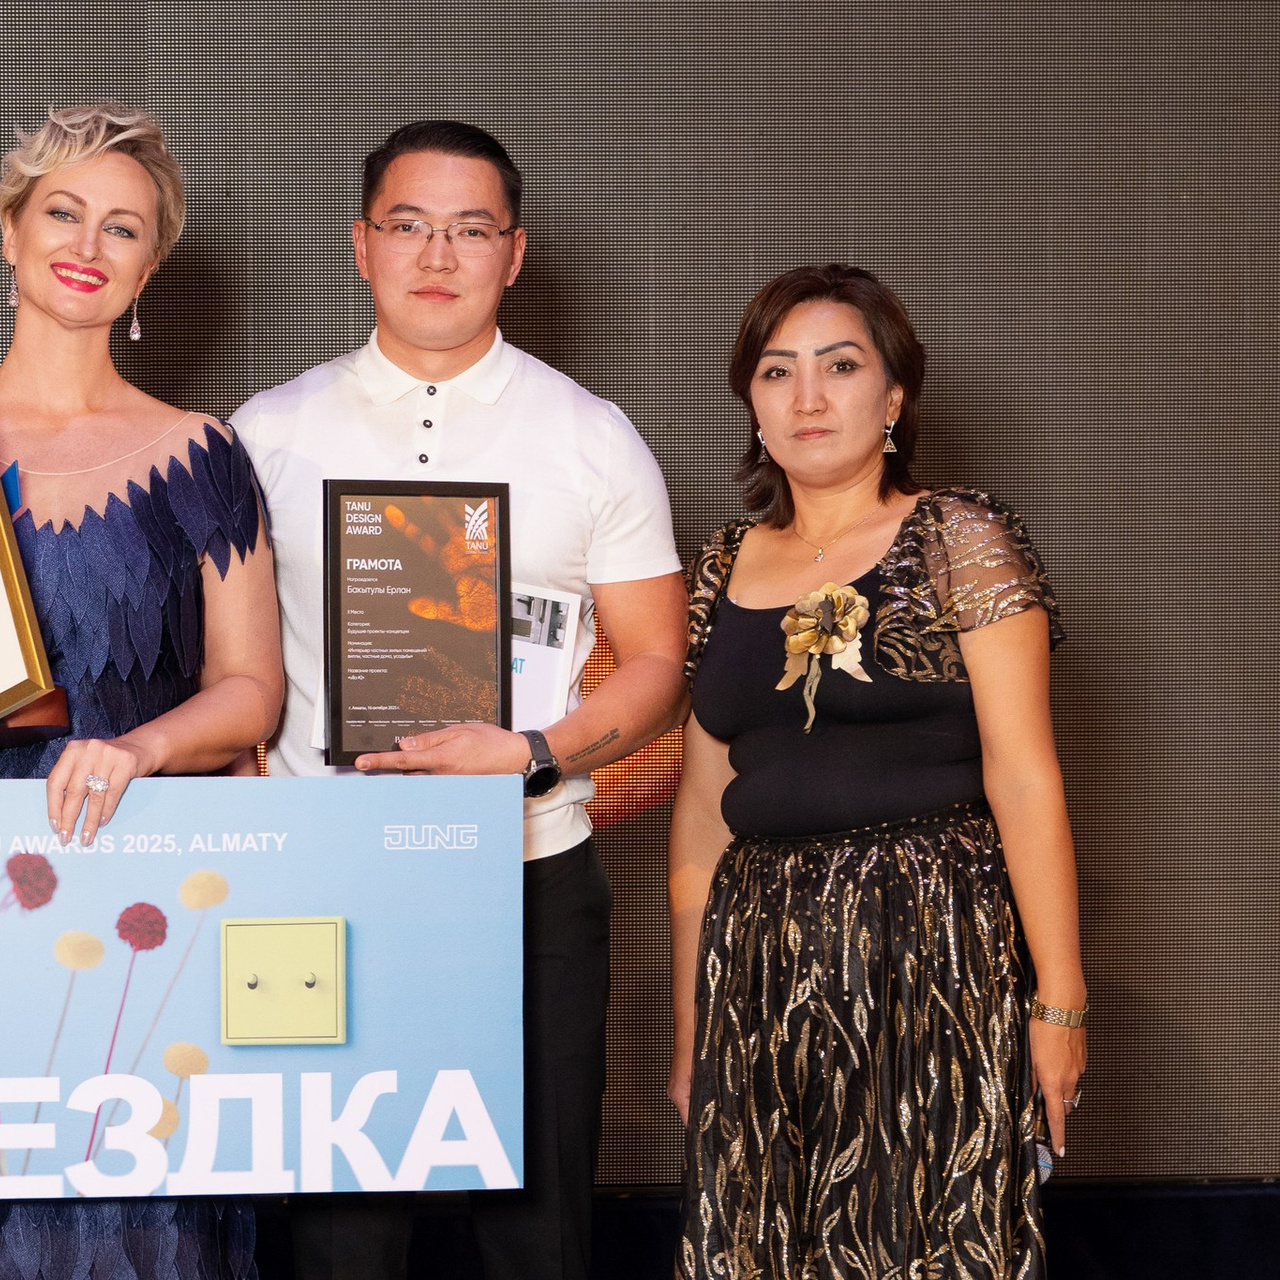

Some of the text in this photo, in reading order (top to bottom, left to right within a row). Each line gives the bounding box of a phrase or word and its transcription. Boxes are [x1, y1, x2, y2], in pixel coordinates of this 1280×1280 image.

[346, 502, 370, 510] TANU
[346, 514, 381, 522] DESIGN
[346, 526, 382, 534] AWARD
[466, 542, 488, 550] TANU
[347, 559, 402, 570] ГРАМОТА
[347, 585, 410, 595] Бакытулы Ерлан
[384, 824, 478, 850] JUNG
[8, 833, 116, 855] AWARDS
[122, 833, 182, 856] 2025,
[189, 831, 289, 853] ALMATY
